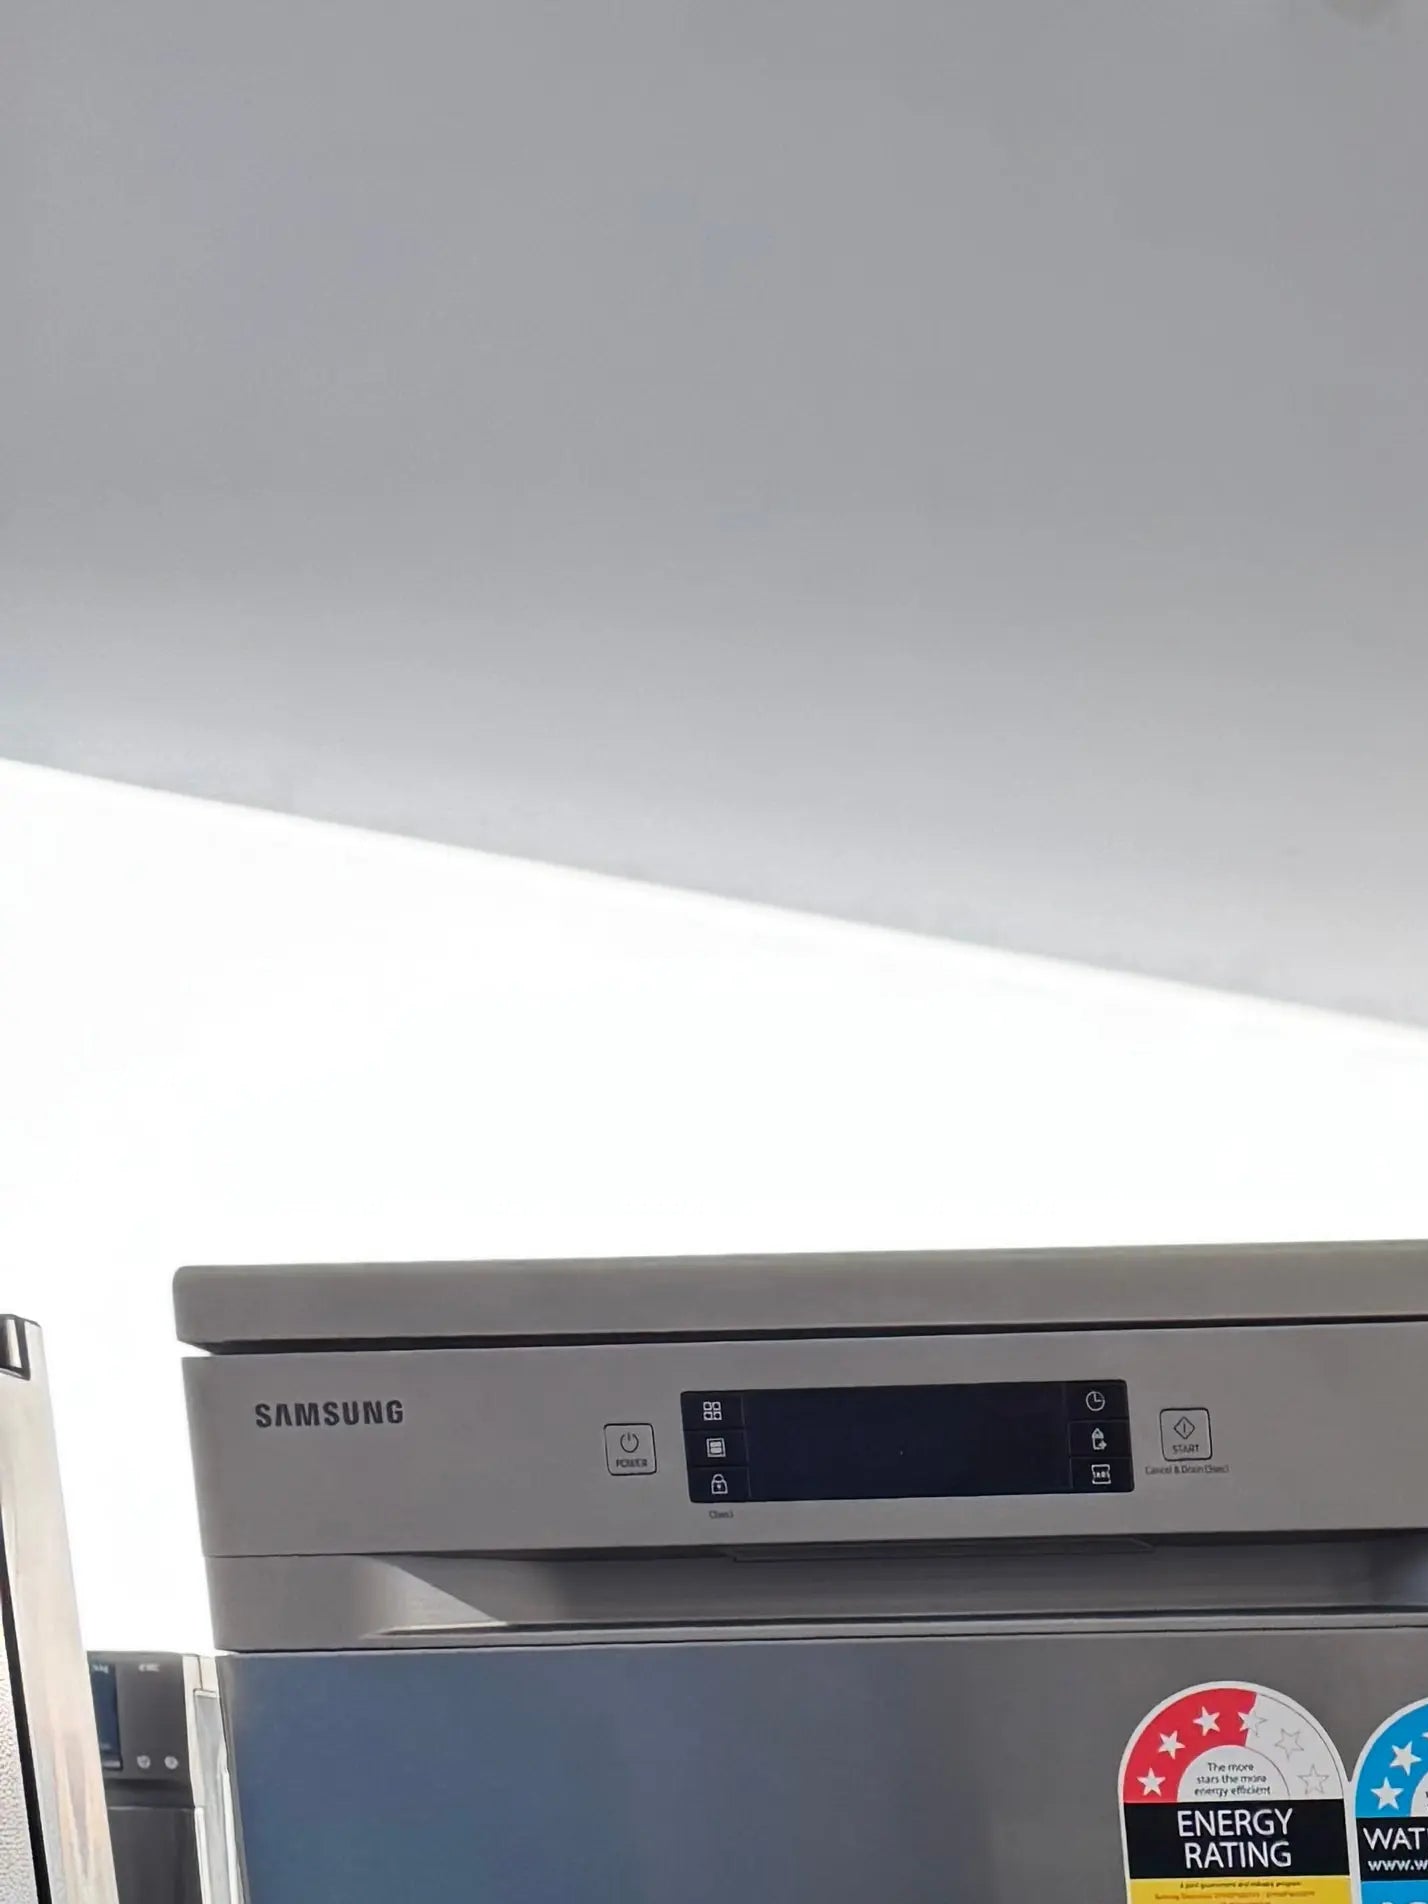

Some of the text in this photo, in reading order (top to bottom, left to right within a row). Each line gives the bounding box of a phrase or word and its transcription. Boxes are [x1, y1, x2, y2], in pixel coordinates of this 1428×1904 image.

[255, 1399, 404, 1428] SAMSUNG
[1172, 1443, 1200, 1454] START
[1207, 1762, 1255, 1772] The more
[1196, 1774, 1268, 1784] stars the more
[1193, 1785, 1271, 1797] energy efficient
[1176, 1808, 1294, 1837] ENERGY
[1184, 1841, 1293, 1869] RATING
